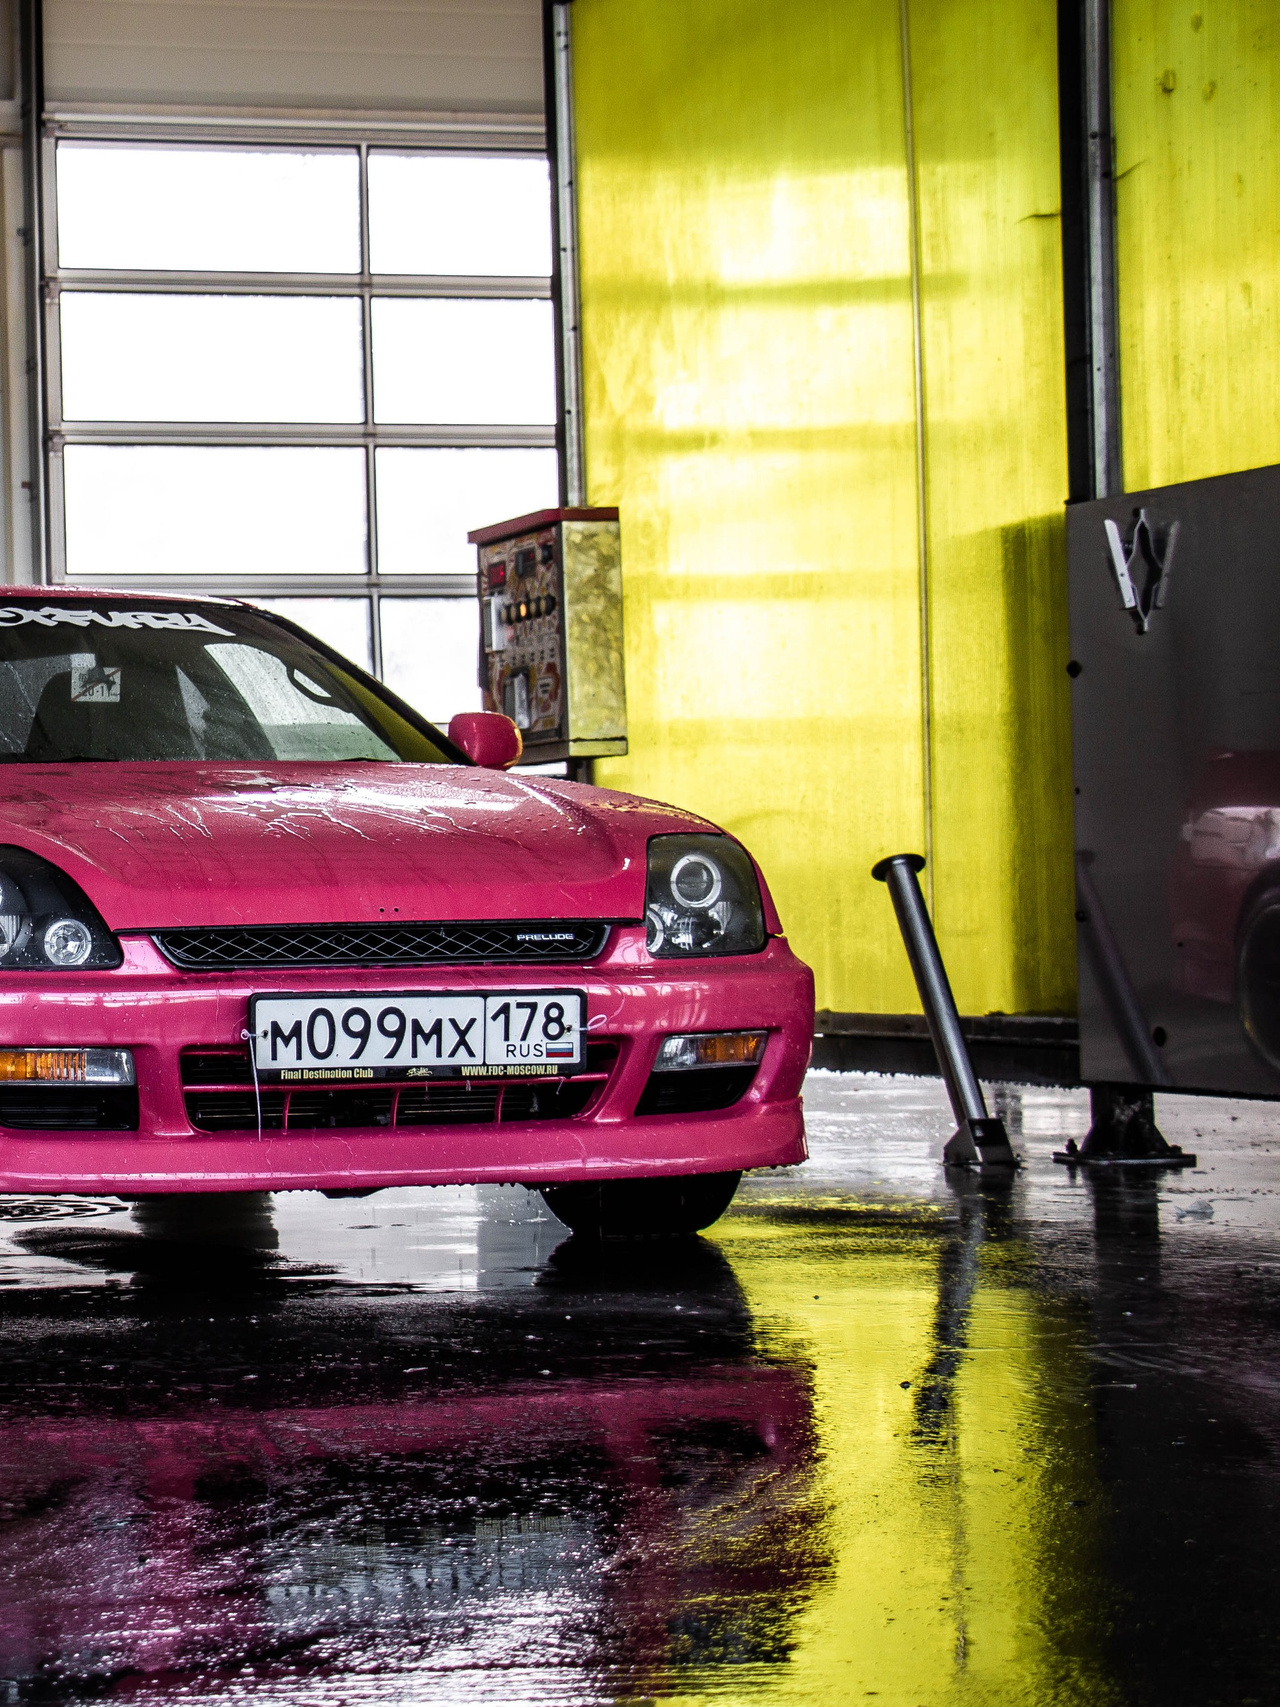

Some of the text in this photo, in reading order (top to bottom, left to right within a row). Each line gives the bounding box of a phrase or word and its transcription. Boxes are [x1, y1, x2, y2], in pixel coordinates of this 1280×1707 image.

[516, 933, 574, 941] PRELUDE
[490, 1001, 565, 1042] 178
[506, 1043, 543, 1058] RUS
[280, 1067, 374, 1080] Final Destination Club
[461, 1064, 558, 1076] WWW.FDC-MOSCOW.RU
